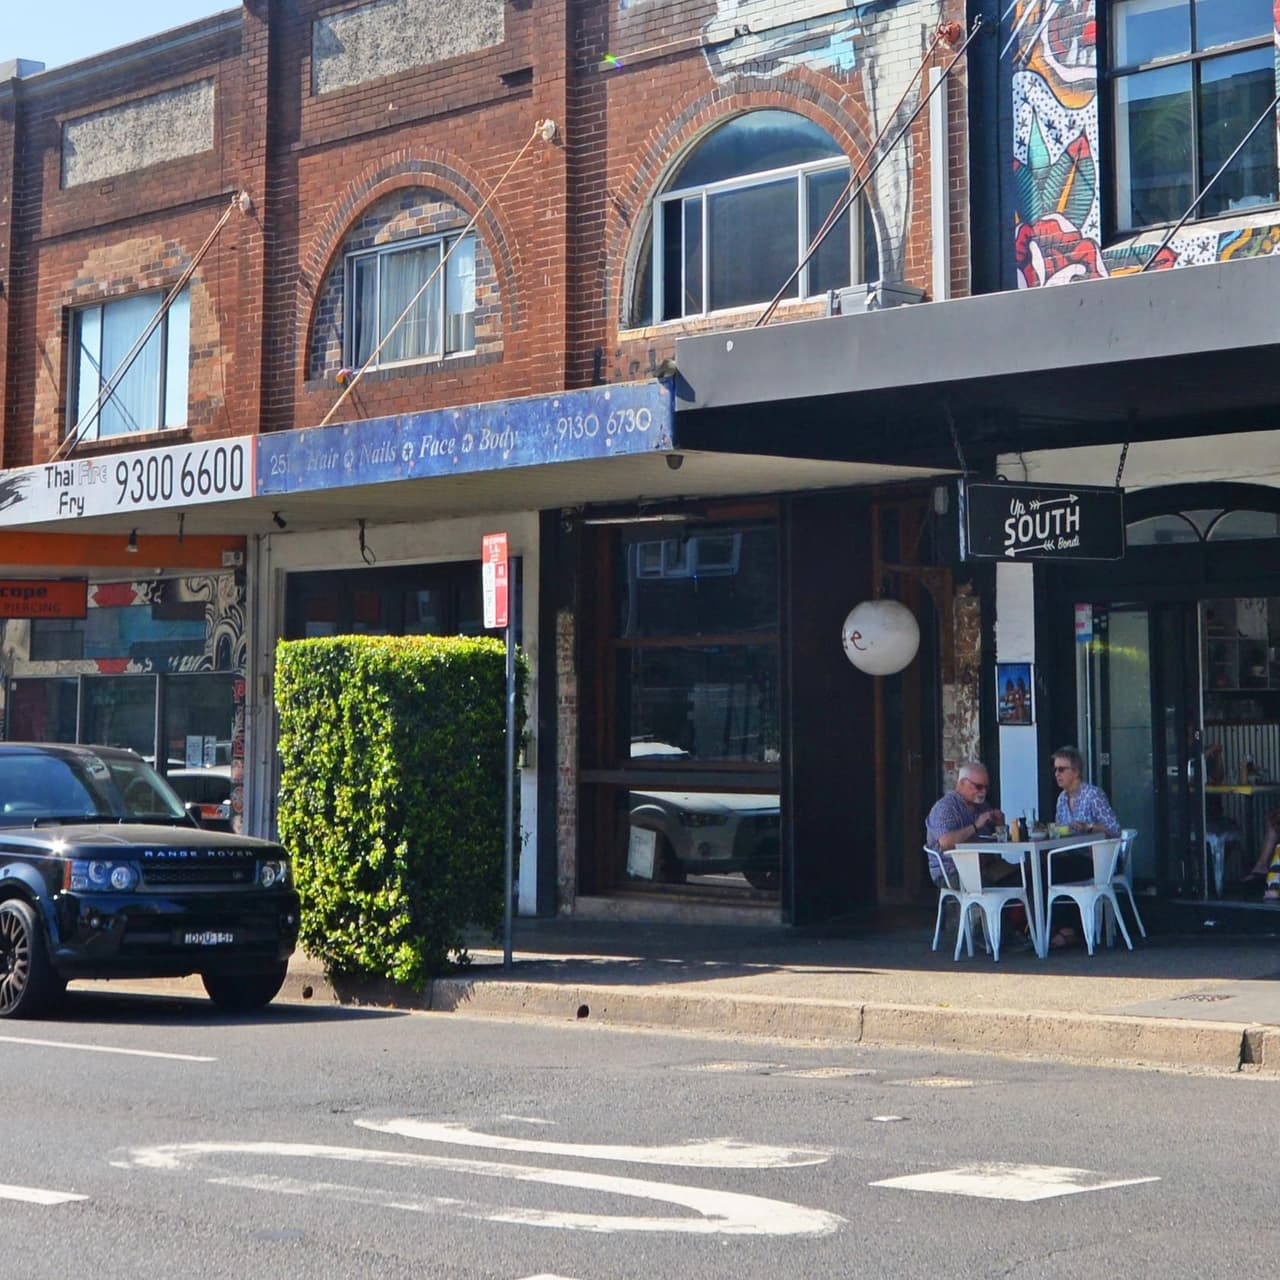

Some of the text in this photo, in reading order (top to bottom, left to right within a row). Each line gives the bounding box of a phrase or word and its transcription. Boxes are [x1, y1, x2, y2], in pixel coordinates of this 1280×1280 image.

[420, 435, 456, 459] Face
[478, 427, 519, 451] Body
[558, 413, 599, 441] 9130
[606, 407, 652, 435] 6730
[44, 465, 75, 489] Thai
[115, 453, 173, 505] 9300
[180, 444, 244, 498] 6600
[58, 491, 85, 515] Fry
[1010, 498, 1025, 518] Up
[1004, 505, 1080, 546] SOUTH
